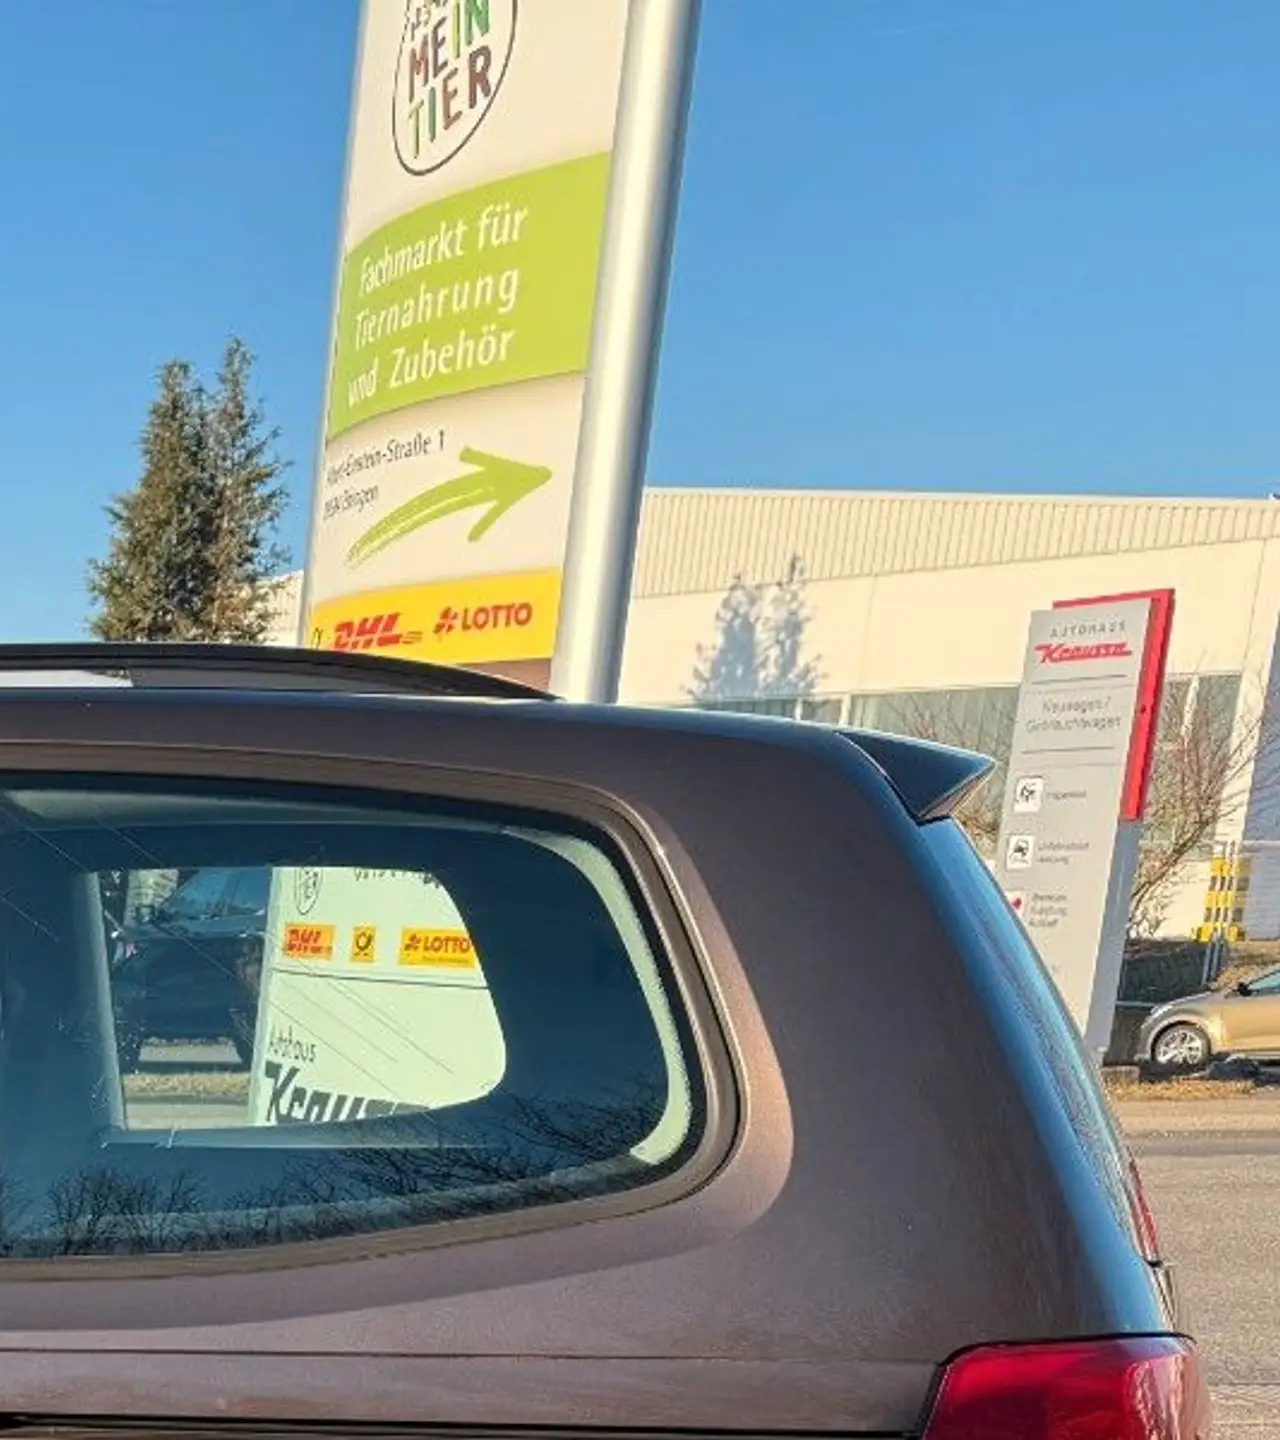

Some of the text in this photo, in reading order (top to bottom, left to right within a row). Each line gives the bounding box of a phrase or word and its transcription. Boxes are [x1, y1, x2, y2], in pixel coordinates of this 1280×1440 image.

[409, 45, 491, 159] TIER
[359, 202, 529, 297] Fachmarkt für
[355, 268, 519, 352] Tiernahrung
[348, 324, 516, 409] und Zubehör
[333, 601, 533, 650] DHL LOTTO
[423, 935, 471, 955] LOTTO
